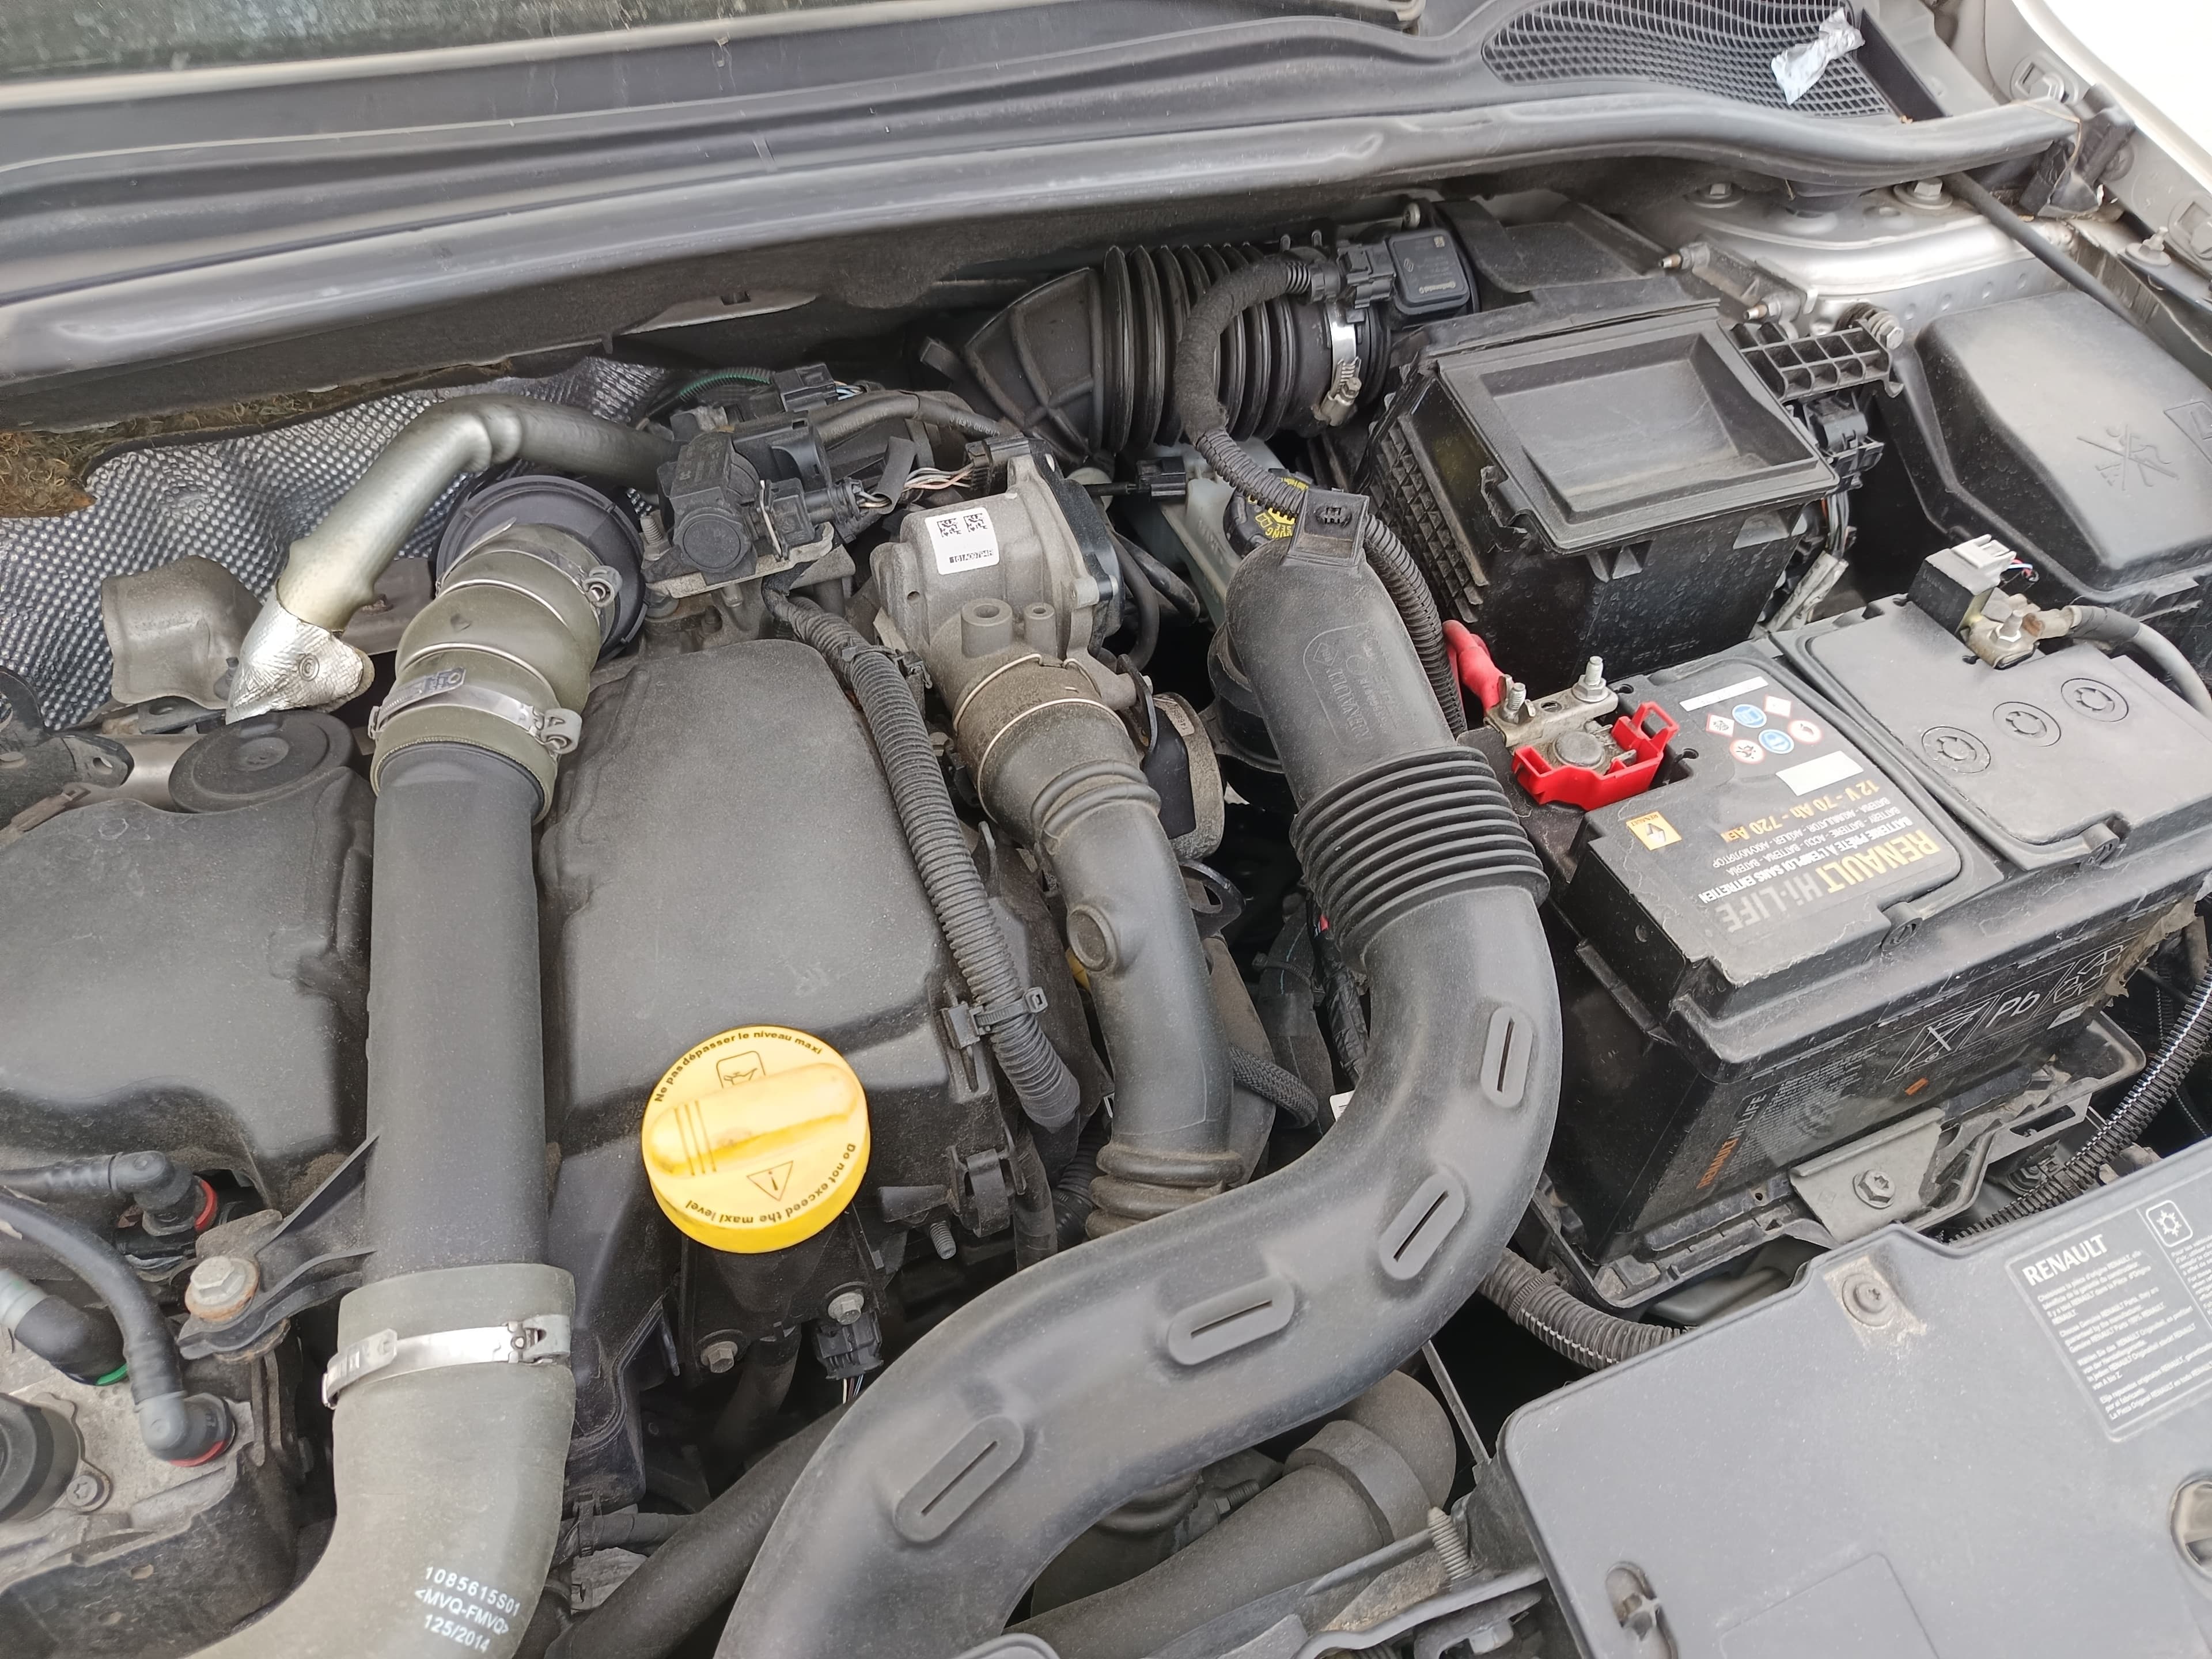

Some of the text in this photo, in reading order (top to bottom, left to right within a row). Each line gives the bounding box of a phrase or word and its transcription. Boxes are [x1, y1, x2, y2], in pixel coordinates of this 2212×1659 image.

[1812, 795, 1833, 812] 70
[1856, 778, 1878, 796] 12
[1748, 815, 1779, 836] 720
[1789, 802, 1813, 820] Ah
[1866, 815, 1911, 840] BATTERIE
[1753, 863, 1783, 882] SANS
[1815, 825, 1940, 895] RENAULT
[1698, 874, 1754, 903] ENTRETIEN
[1986, 990, 2041, 1028] Pb
[654, 1029, 823, 1103] Ne pas dépasser le niveau maxi
[685, 1143, 856, 1226] Do not exceed the maxi level
[2021, 1234, 2108, 1286] RENAULT
[424, 1566, 521, 1618] 1085615S01
[424, 1614, 491, 1653] 125/2014
